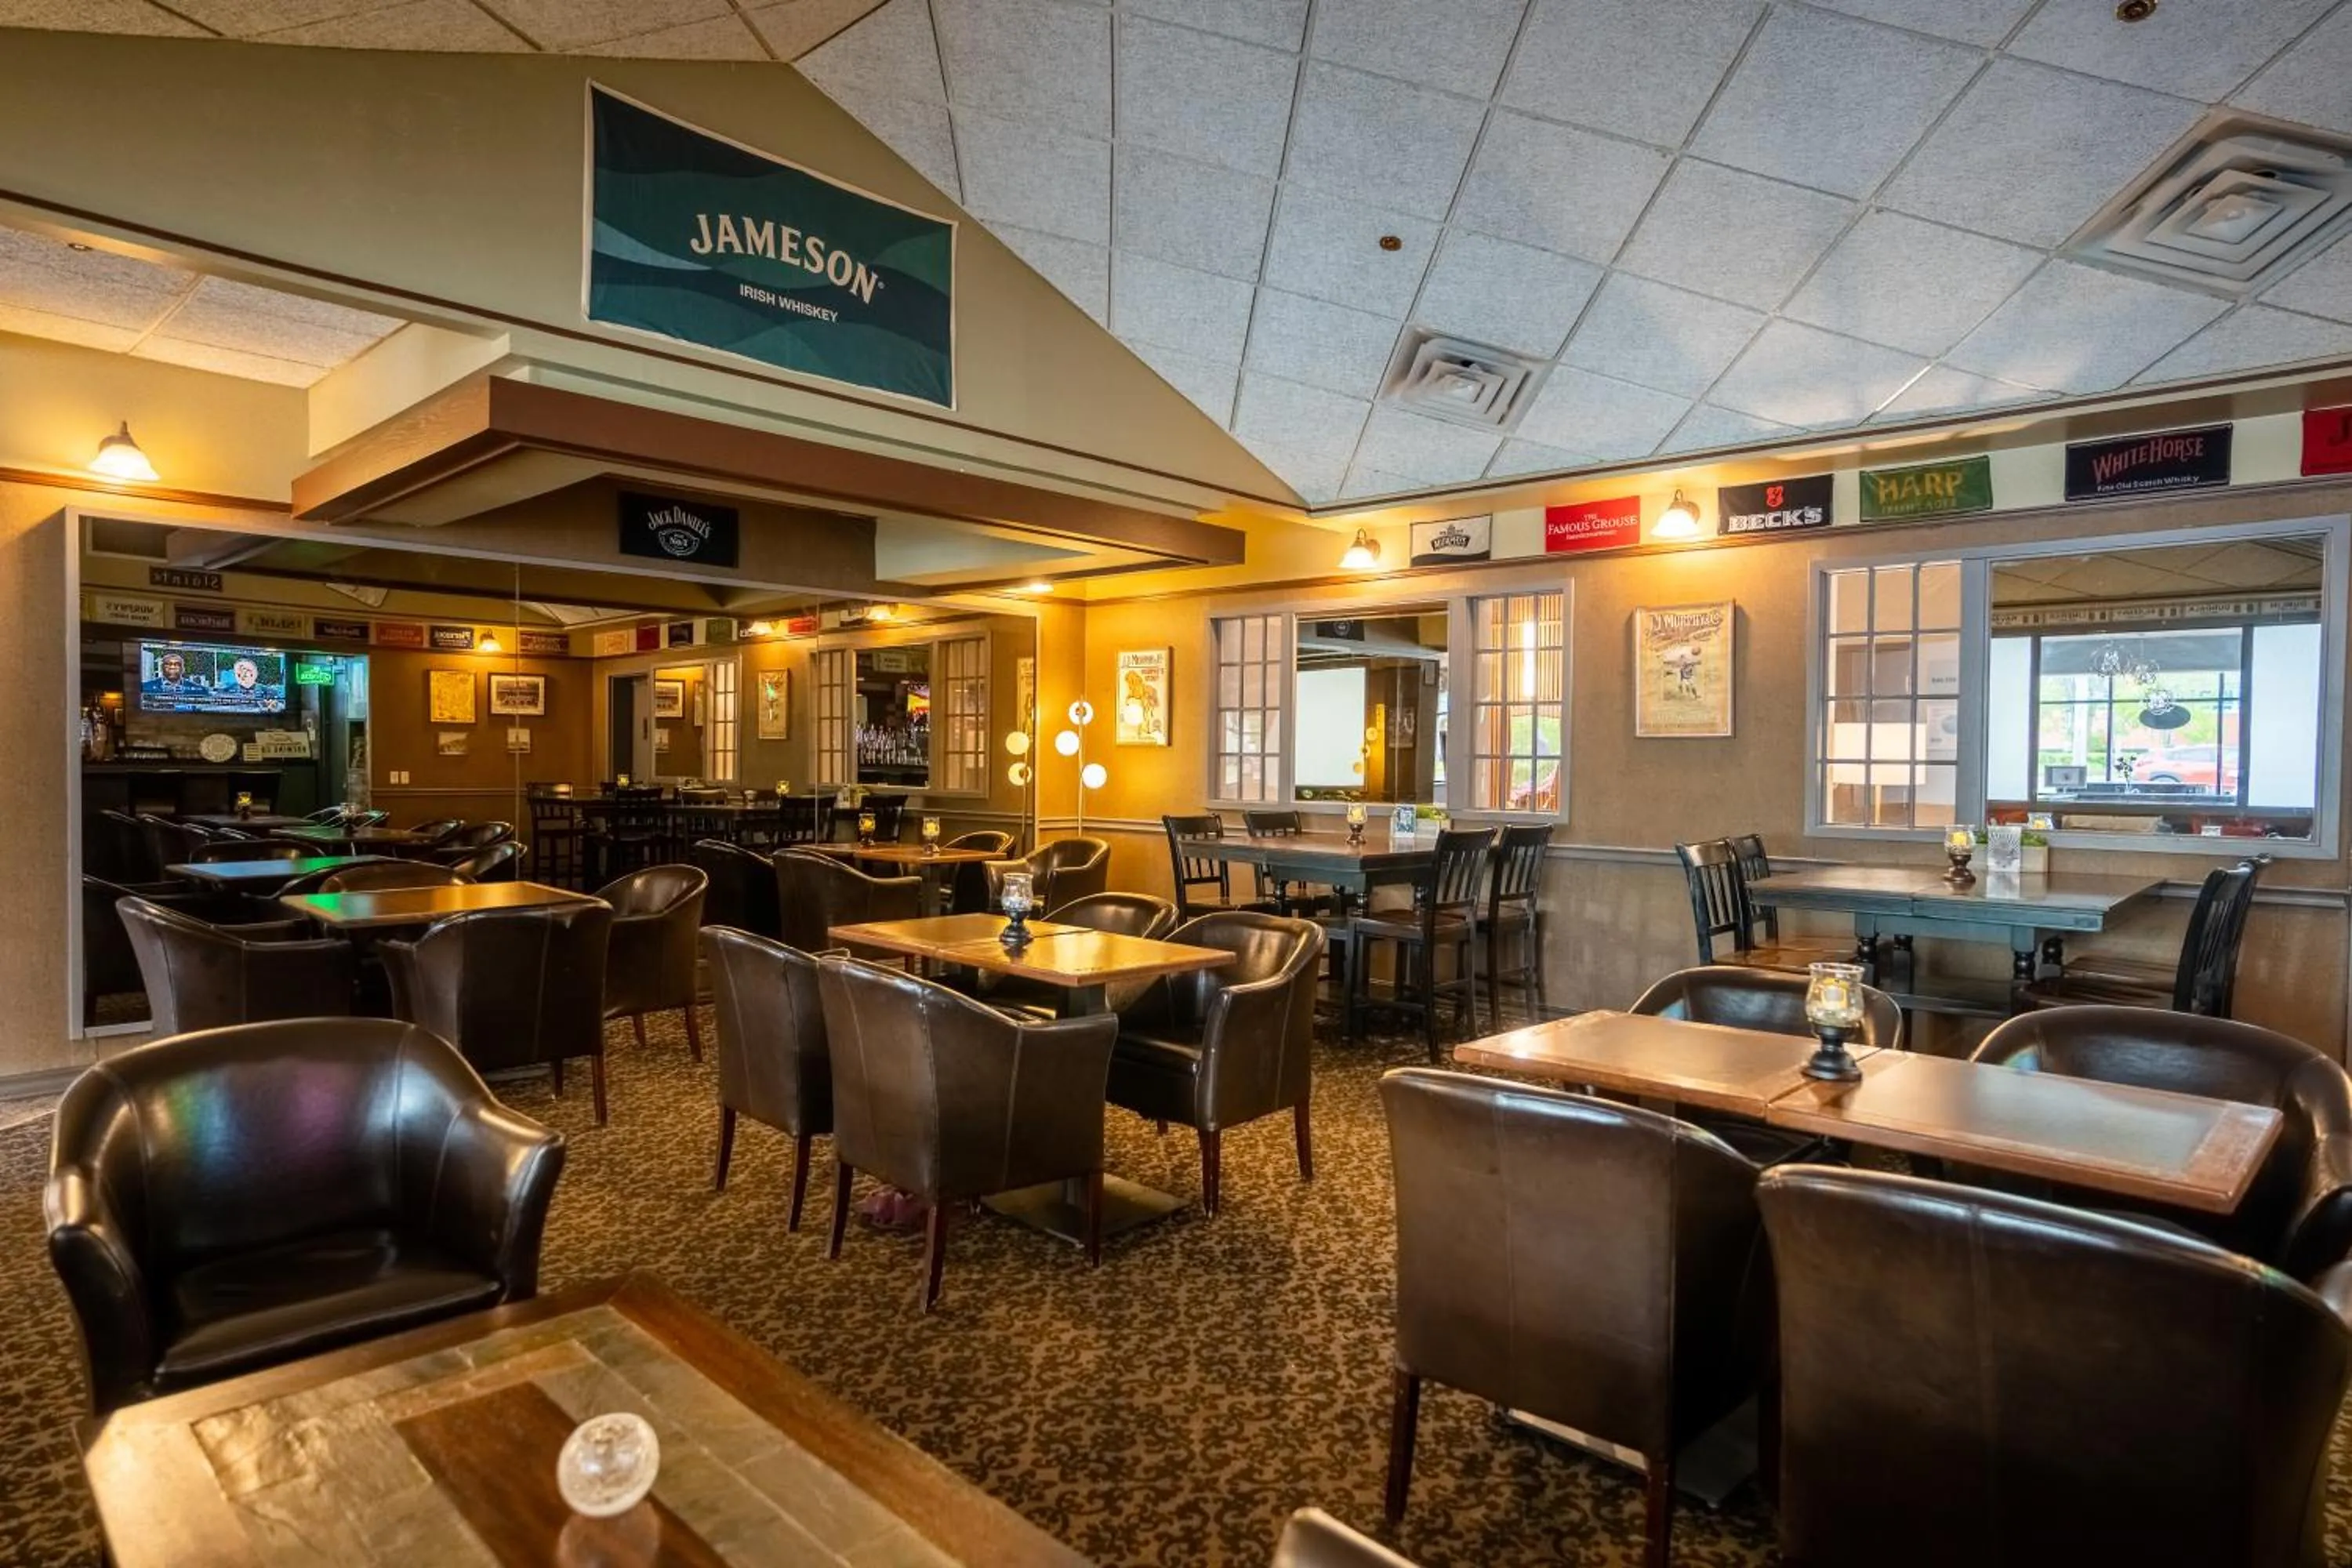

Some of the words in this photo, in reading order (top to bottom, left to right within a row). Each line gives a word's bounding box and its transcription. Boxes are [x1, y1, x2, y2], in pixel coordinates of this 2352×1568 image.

[690, 213, 879, 304] JAMESON
[739, 283, 776, 306] IRISH
[779, 295, 838, 323] WHISKEY
[2092, 445, 2149, 484] WHITE
[2149, 437, 2205, 463] HORSE
[1878, 472, 1962, 504] HARP
[648, 510, 673, 531] JACK
[1548, 521, 1591, 535] FAMOUS
[1592, 514, 1638, 529] GROUSE
[1728, 506, 1823, 532] BECK'S
